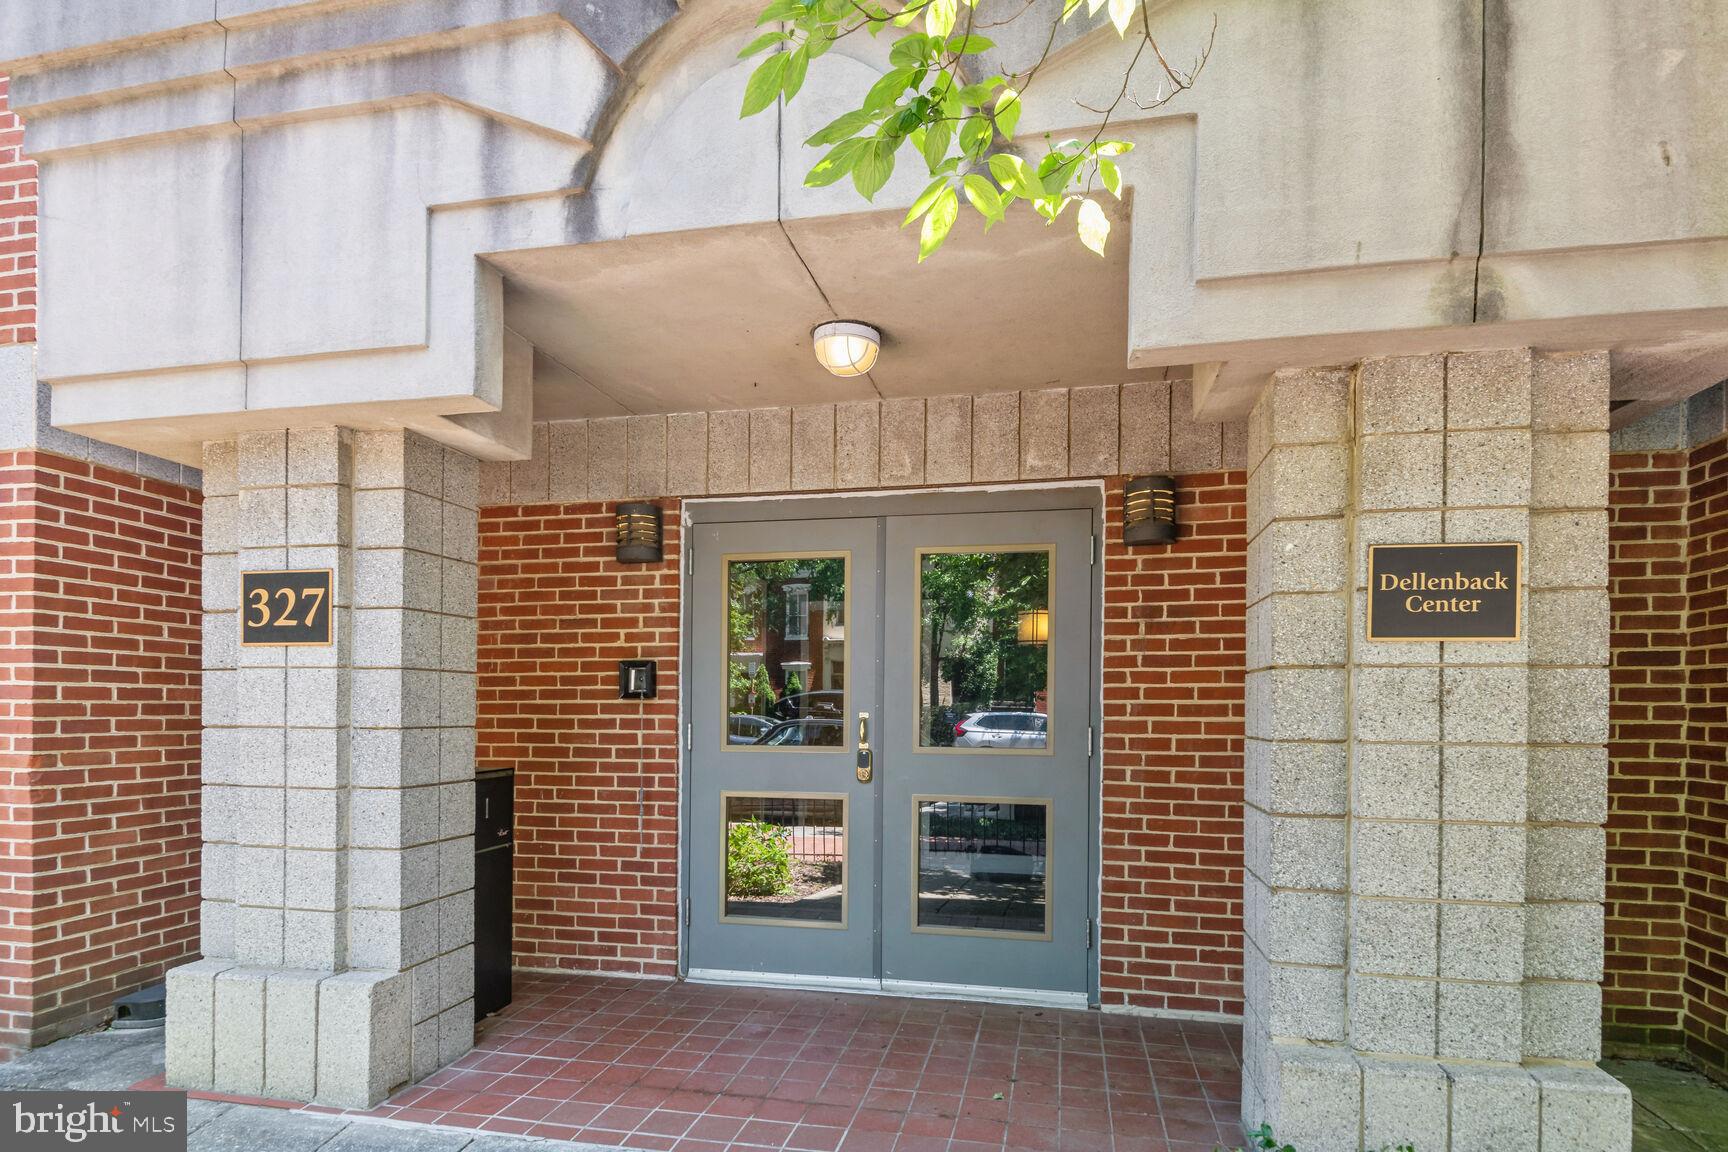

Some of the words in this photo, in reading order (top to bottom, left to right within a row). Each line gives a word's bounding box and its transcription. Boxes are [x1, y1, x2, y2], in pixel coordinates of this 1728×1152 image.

[1379, 571, 1509, 591] Dellenback
[247, 587, 325, 628] 327
[1405, 595, 1482, 613] Center
